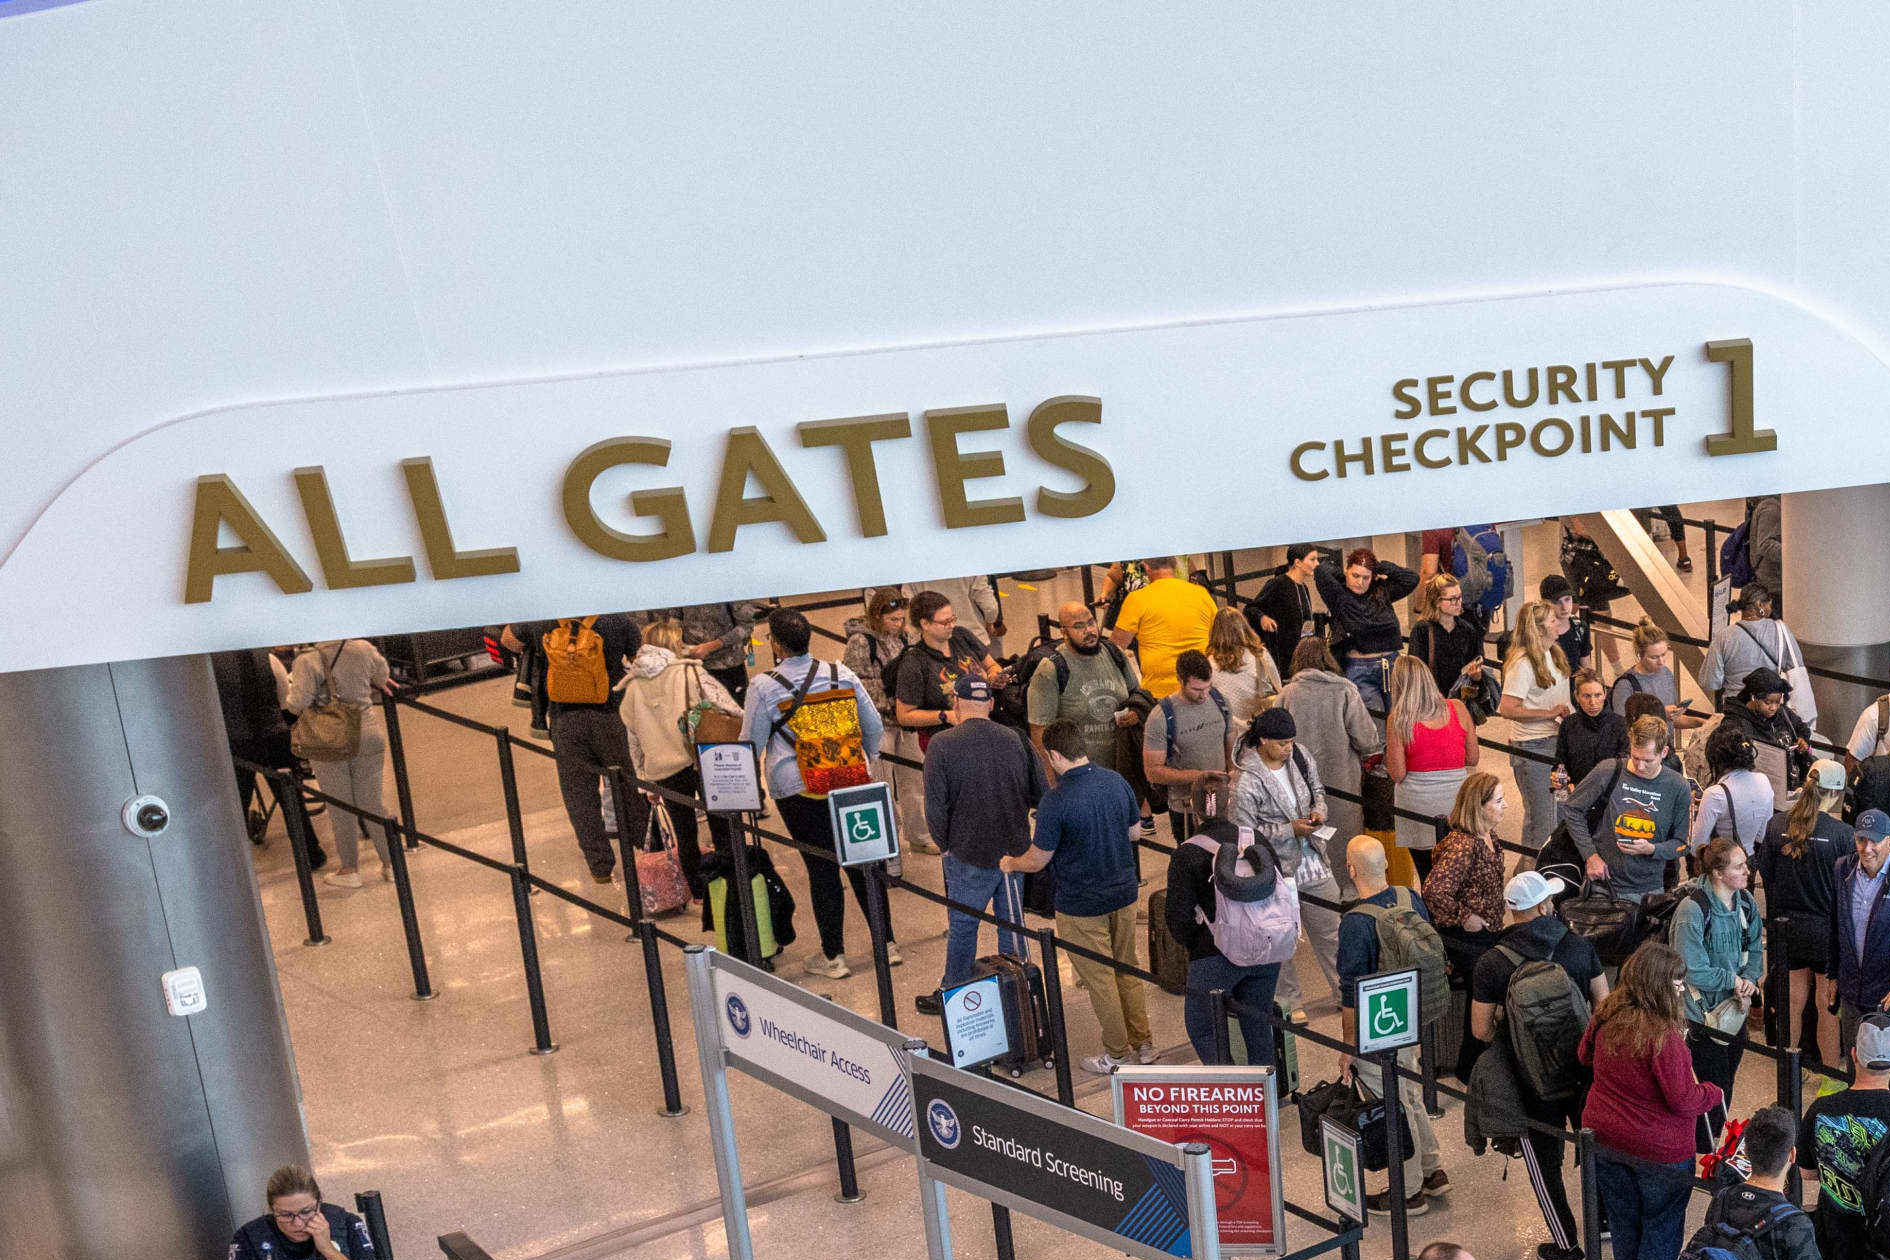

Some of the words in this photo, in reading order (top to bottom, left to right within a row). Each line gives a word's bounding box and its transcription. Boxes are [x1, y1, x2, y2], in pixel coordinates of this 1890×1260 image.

[1392, 355, 1675, 420] SECURITY
[1706, 338, 1777, 457] 1
[1290, 407, 1676, 482] CHECKPOINT
[184, 455, 521, 604] ALL
[563, 394, 1116, 562] GATES
[760, 1016, 827, 1063] Wheelchair
[831, 1051, 871, 1085] Access
[1133, 1087, 1165, 1102] NO
[1170, 1087, 1264, 1102] FIREARMS
[1139, 1104, 1189, 1114] BEYOND
[1192, 1104, 1219, 1114] THIS
[1222, 1104, 1260, 1114] POINT
